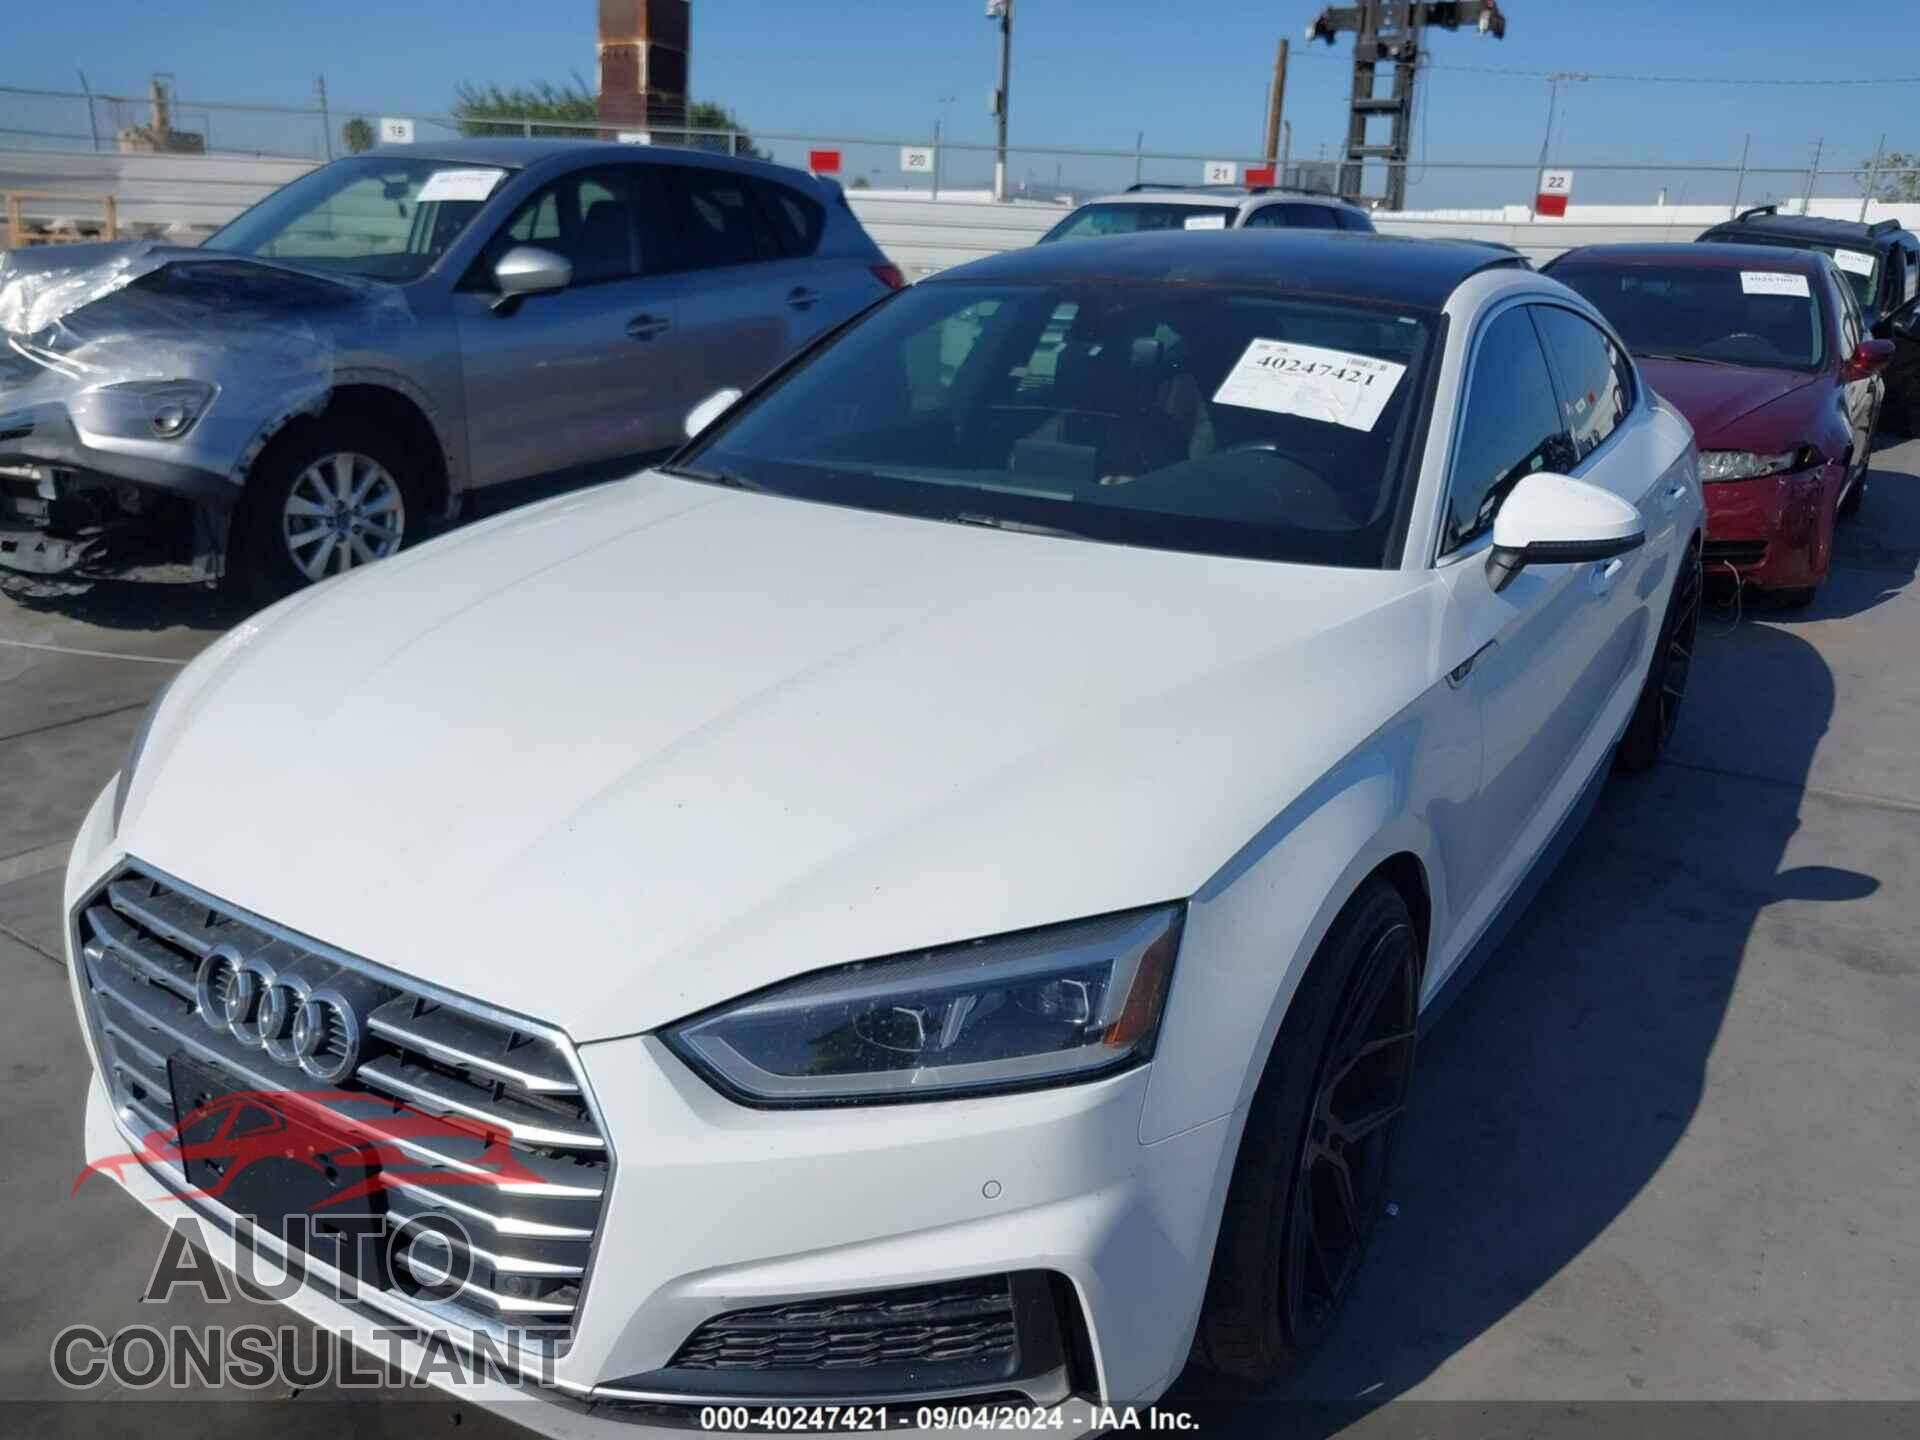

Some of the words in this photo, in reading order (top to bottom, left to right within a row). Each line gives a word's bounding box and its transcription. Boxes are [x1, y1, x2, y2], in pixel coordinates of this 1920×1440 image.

[1213, 168, 1228, 180] 21
[1548, 176, 1565, 188] 22
[1256, 355, 1376, 386] 40247421
